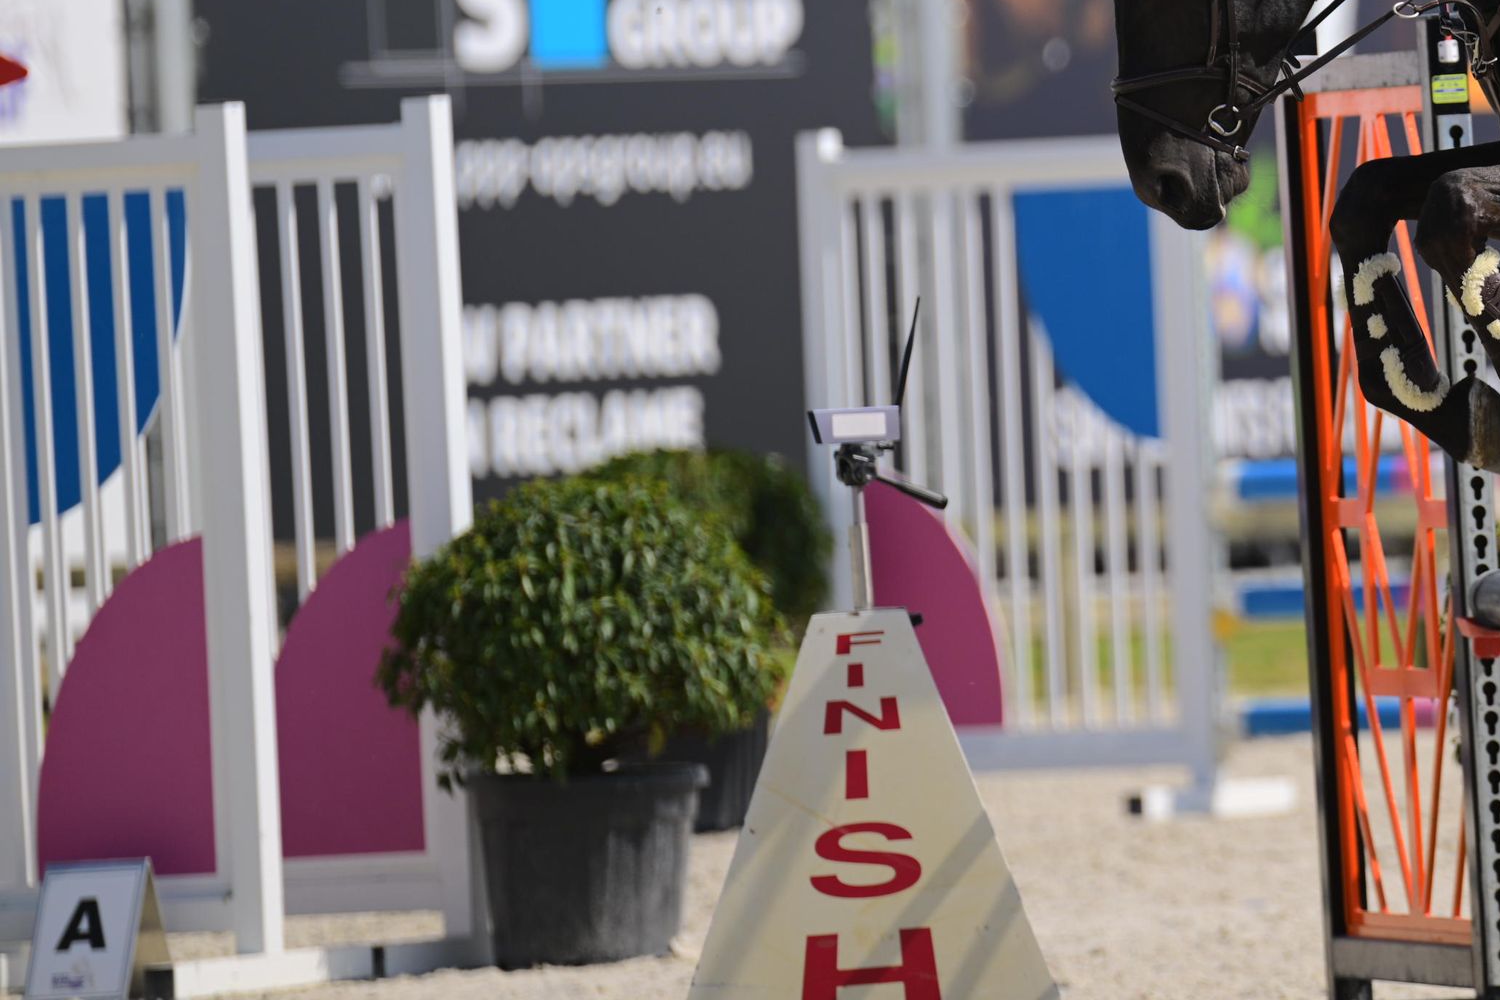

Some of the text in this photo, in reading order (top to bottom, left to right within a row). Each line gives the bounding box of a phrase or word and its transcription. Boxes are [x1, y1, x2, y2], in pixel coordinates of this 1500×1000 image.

[500, 292, 723, 386] PARTNER
[801, 630, 942, 1000] FINISH
[55, 895, 107, 952] A
